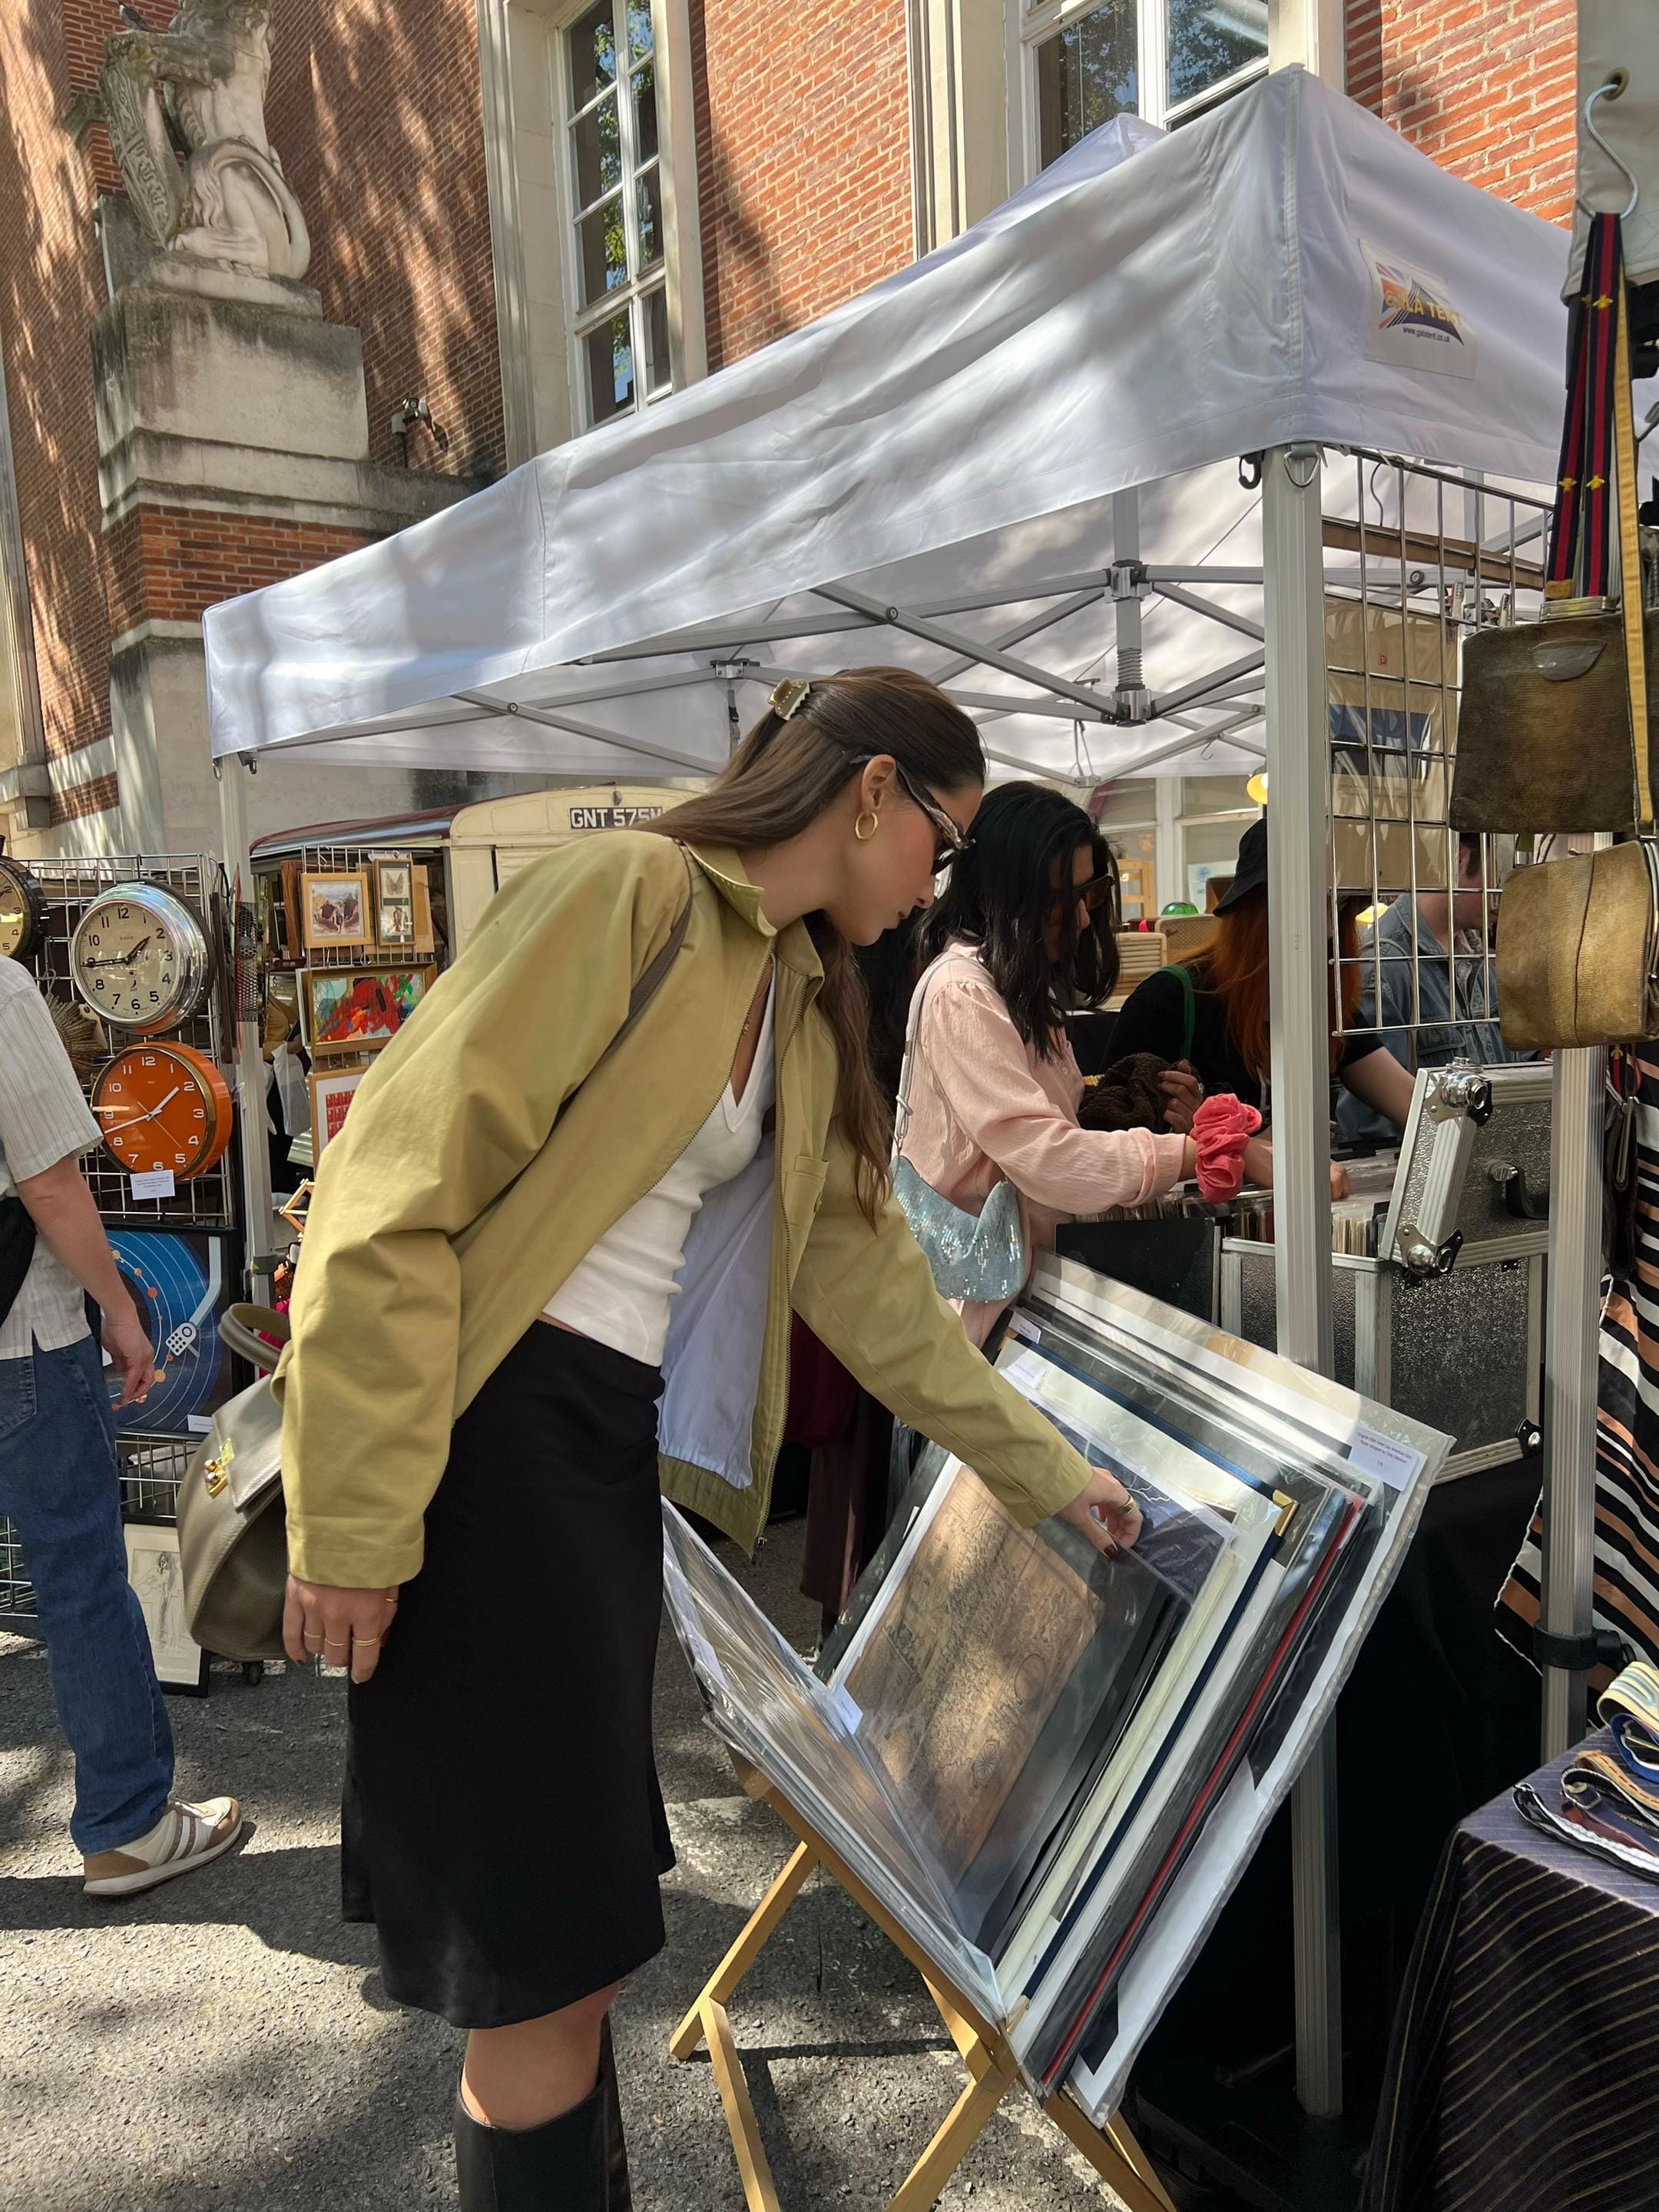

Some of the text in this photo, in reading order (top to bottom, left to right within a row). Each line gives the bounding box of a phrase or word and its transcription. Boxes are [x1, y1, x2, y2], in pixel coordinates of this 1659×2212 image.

[571, 808, 608, 828] GNT
[118, 907, 130, 919] 12
[142, 912, 147, 924] 1
[101, 916, 110, 929] 11
[156, 928, 165, 939] 2
[88, 935, 100, 946] 10
[164, 950, 173, 962] 3
[162, 972, 171, 985] 4
[95, 979, 105, 990] 8
[112, 993, 121, 1005] 7
[149, 991, 159, 1002] 5
[131, 998, 141, 1010] 6
[141, 1056, 156, 1066] 12
[123, 1065, 132, 1075] 11
[170, 1063, 174, 1074] 1
[109, 1083, 122, 1092] 10
[184, 1081, 195, 1091] 2
[104, 1111, 114, 1119] 9
[193, 1108, 204, 1118] 3
[113, 1137, 124, 1146] 8
[188, 1135, 200, 1146] 4
[128, 1154, 139, 1164] 7
[174, 1154, 186, 1164] 5
[153, 1161, 164, 1171] 6
